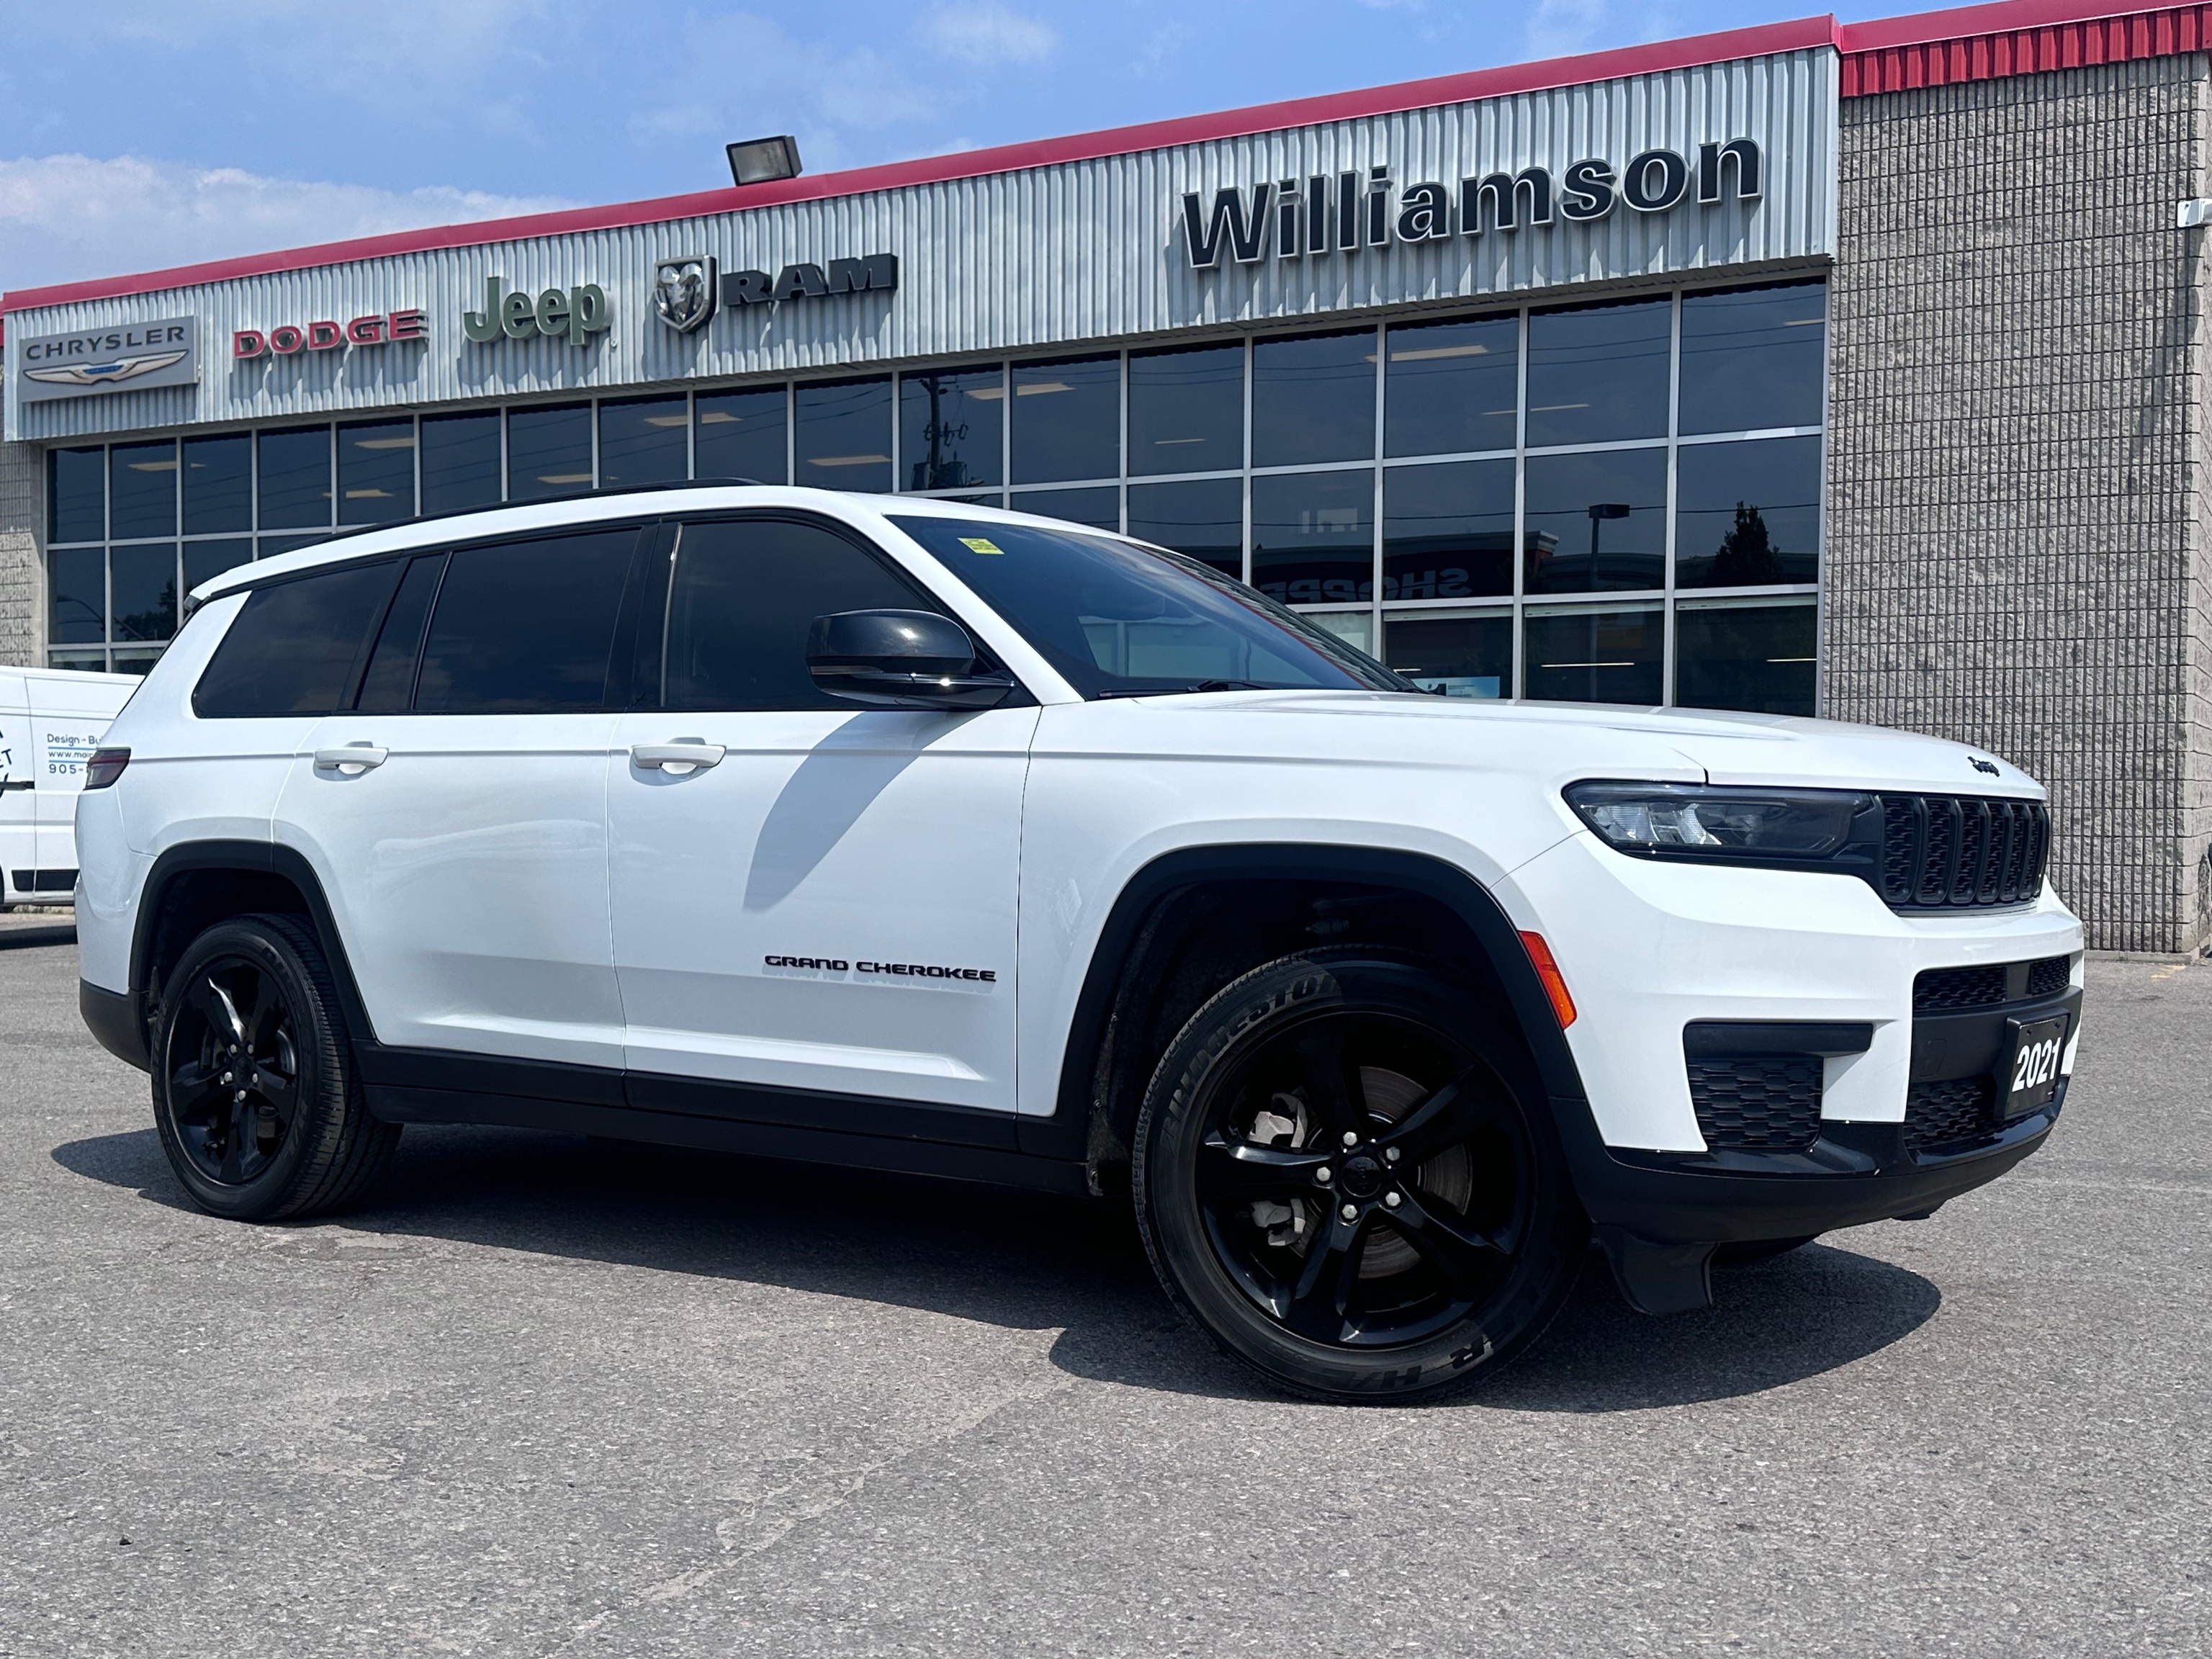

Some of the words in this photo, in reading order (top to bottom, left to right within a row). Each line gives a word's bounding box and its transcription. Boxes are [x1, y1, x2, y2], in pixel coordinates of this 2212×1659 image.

[1182, 137, 1763, 269] Williamson
[721, 253, 899, 307] RAM
[233, 309, 428, 359] DODGE
[463, 276, 613, 346] Jeep
[25, 325, 185, 360] CHRYSLER
[47, 733, 80, 747] Design
[49, 763, 88, 774] 905-
[764, 955, 849, 971] GRAND
[855, 961, 997, 982] CHEROKEE
[2012, 1037, 2062, 1092] 2021
